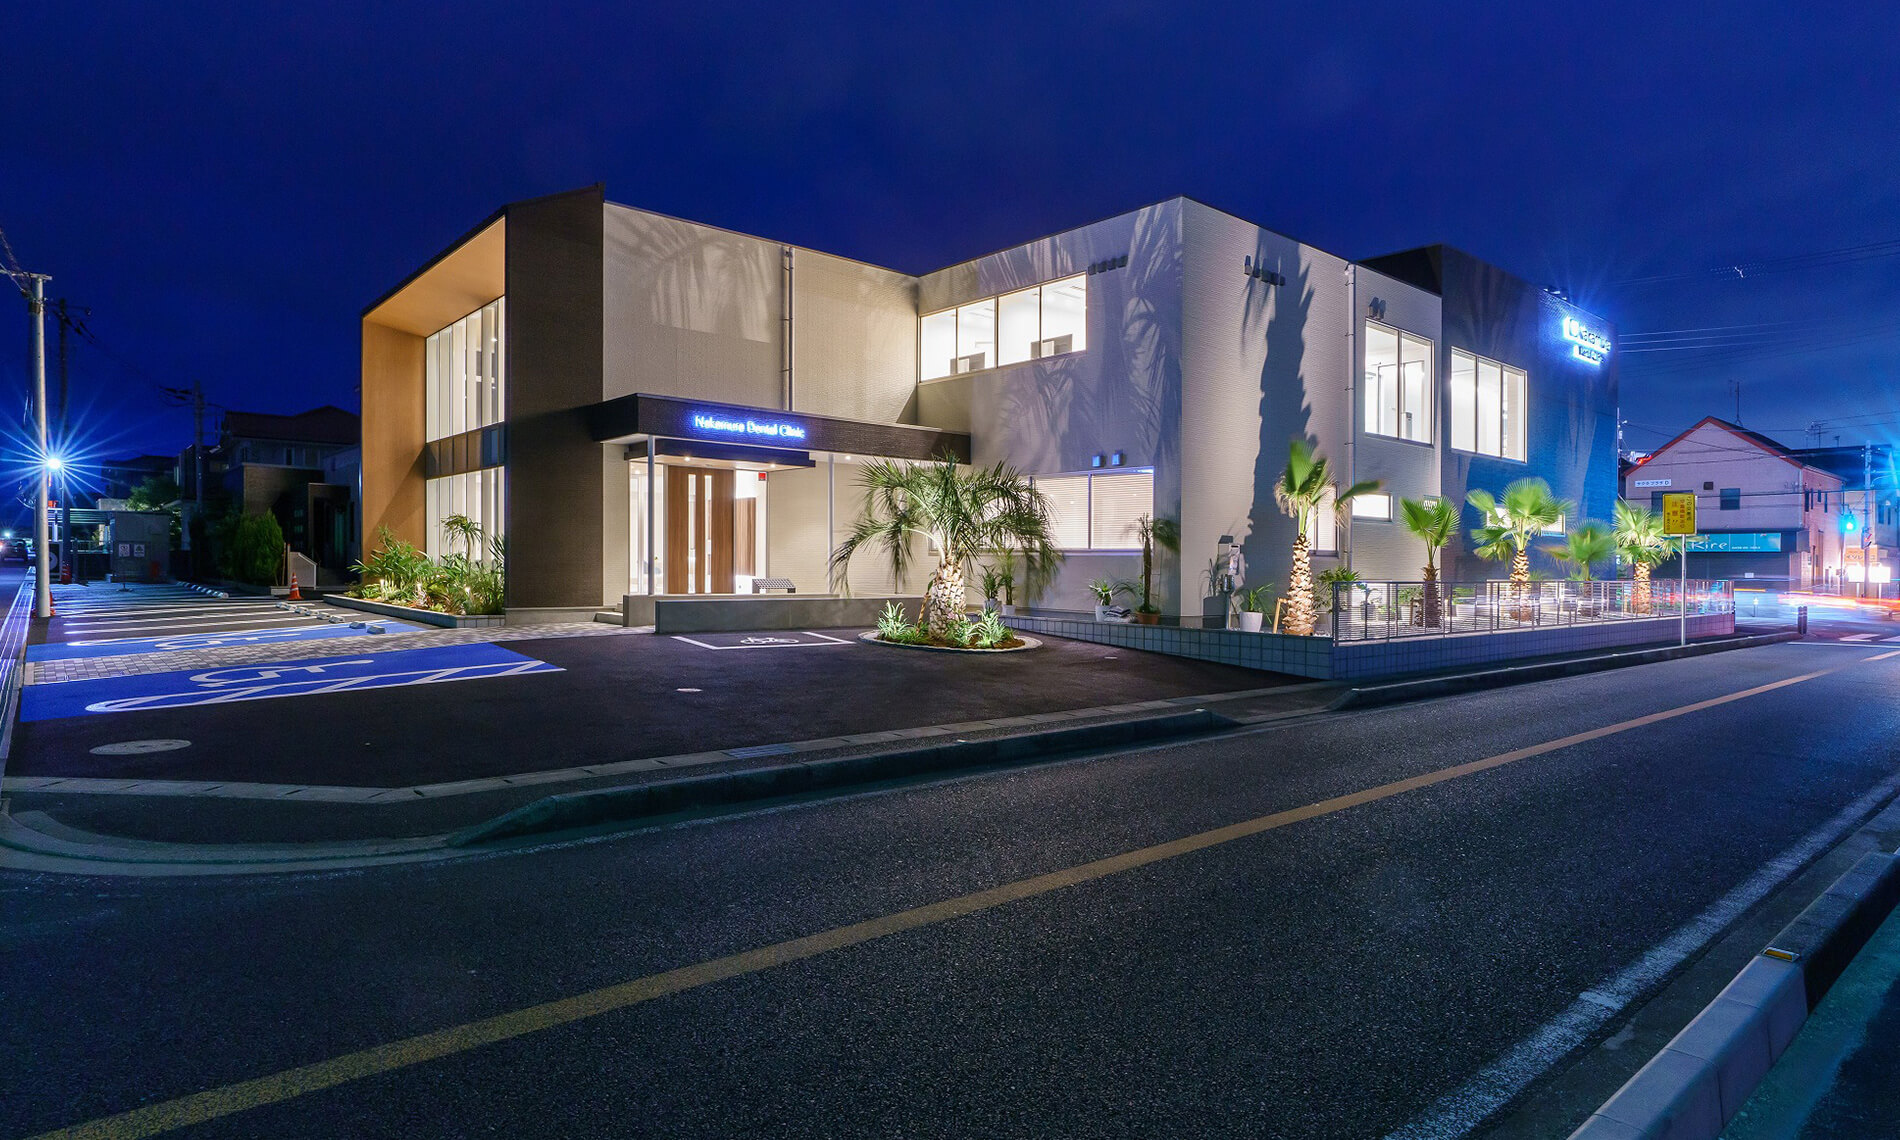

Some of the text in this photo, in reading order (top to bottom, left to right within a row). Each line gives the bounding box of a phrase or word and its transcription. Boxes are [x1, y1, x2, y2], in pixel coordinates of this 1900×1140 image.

[695, 415, 806, 438] Nakamura Dental Clinic
